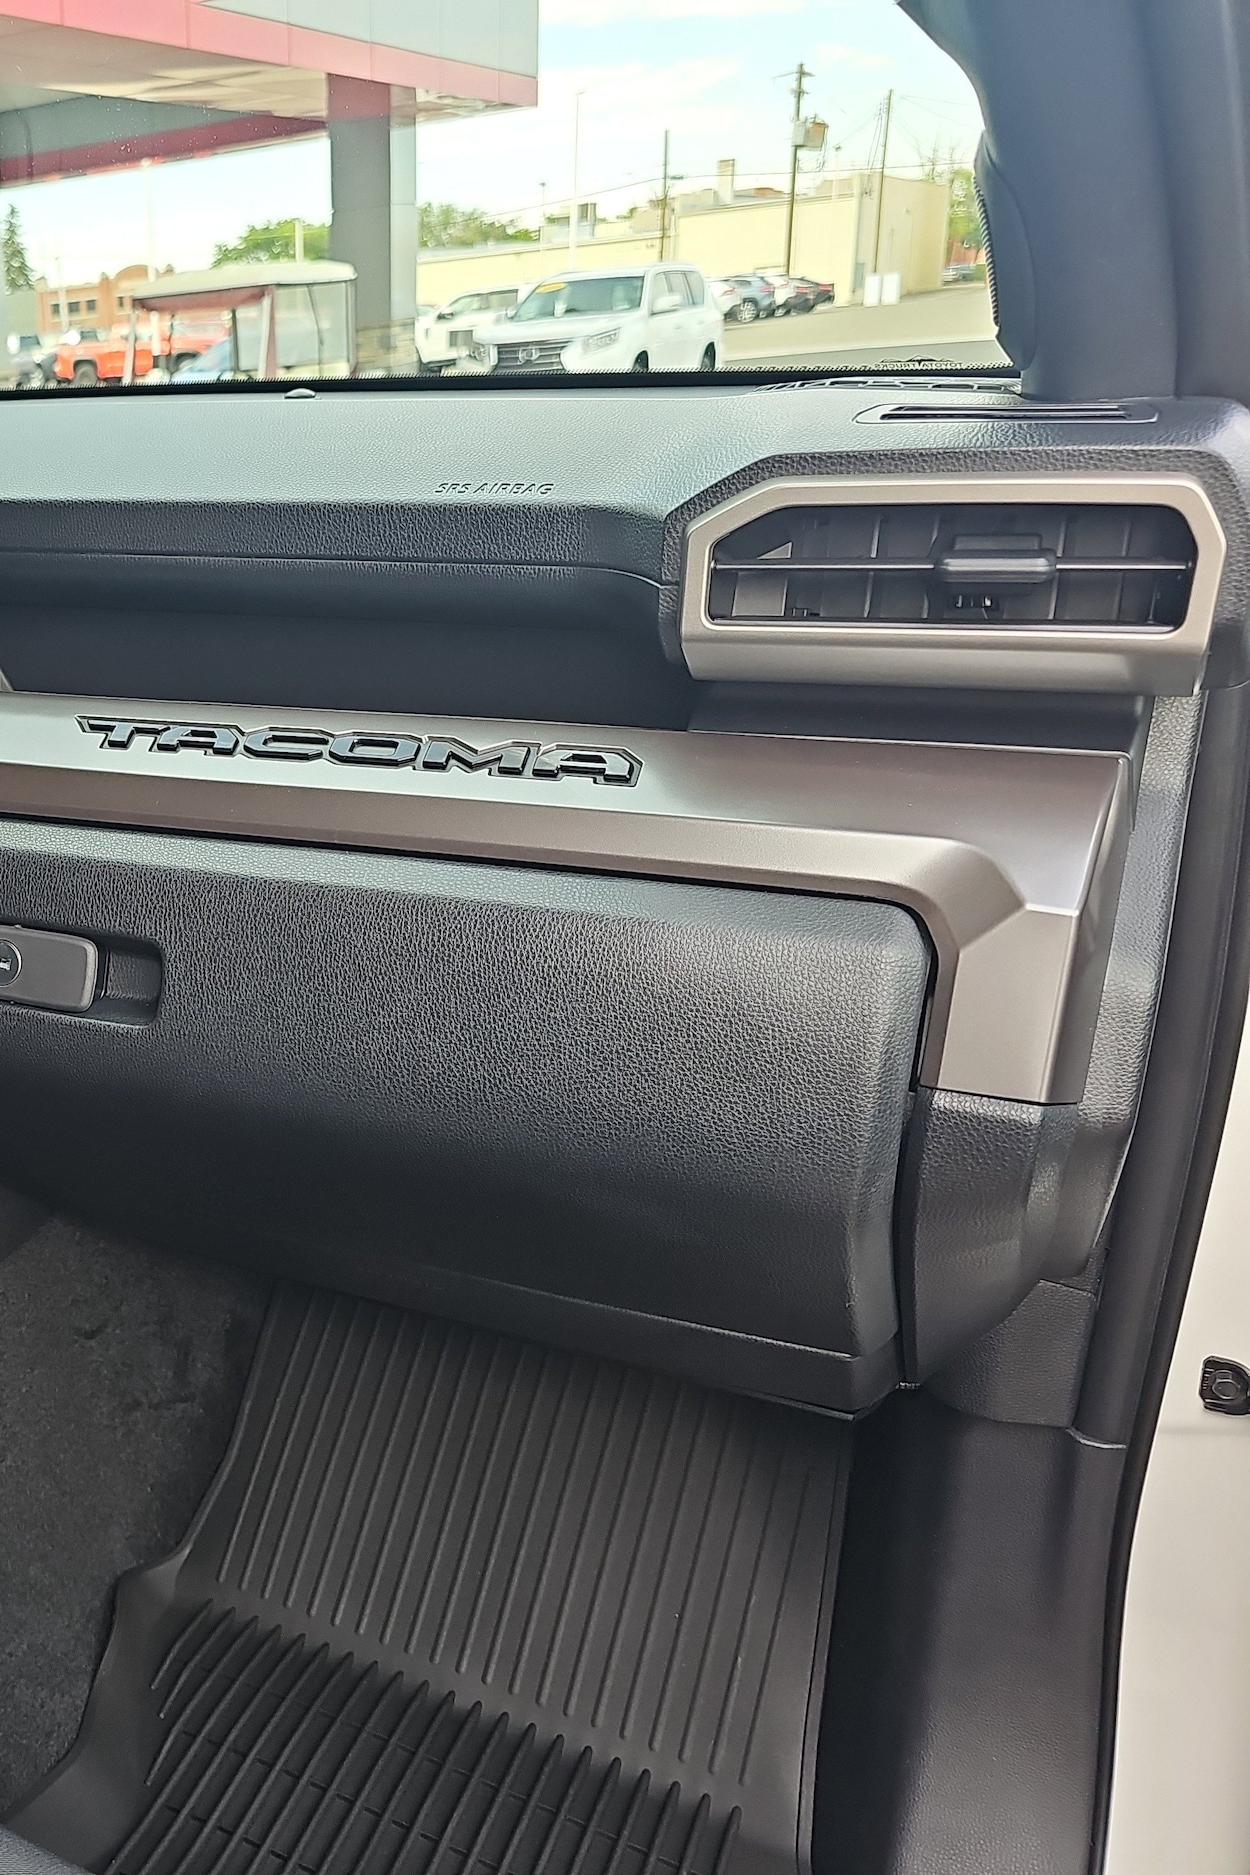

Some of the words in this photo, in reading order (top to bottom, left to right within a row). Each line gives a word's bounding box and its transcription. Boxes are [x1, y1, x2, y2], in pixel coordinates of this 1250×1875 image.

[434, 482, 471, 494] SRS
[473, 482, 554, 494] AIRBAG
[75, 714, 644, 788] TACOMA
